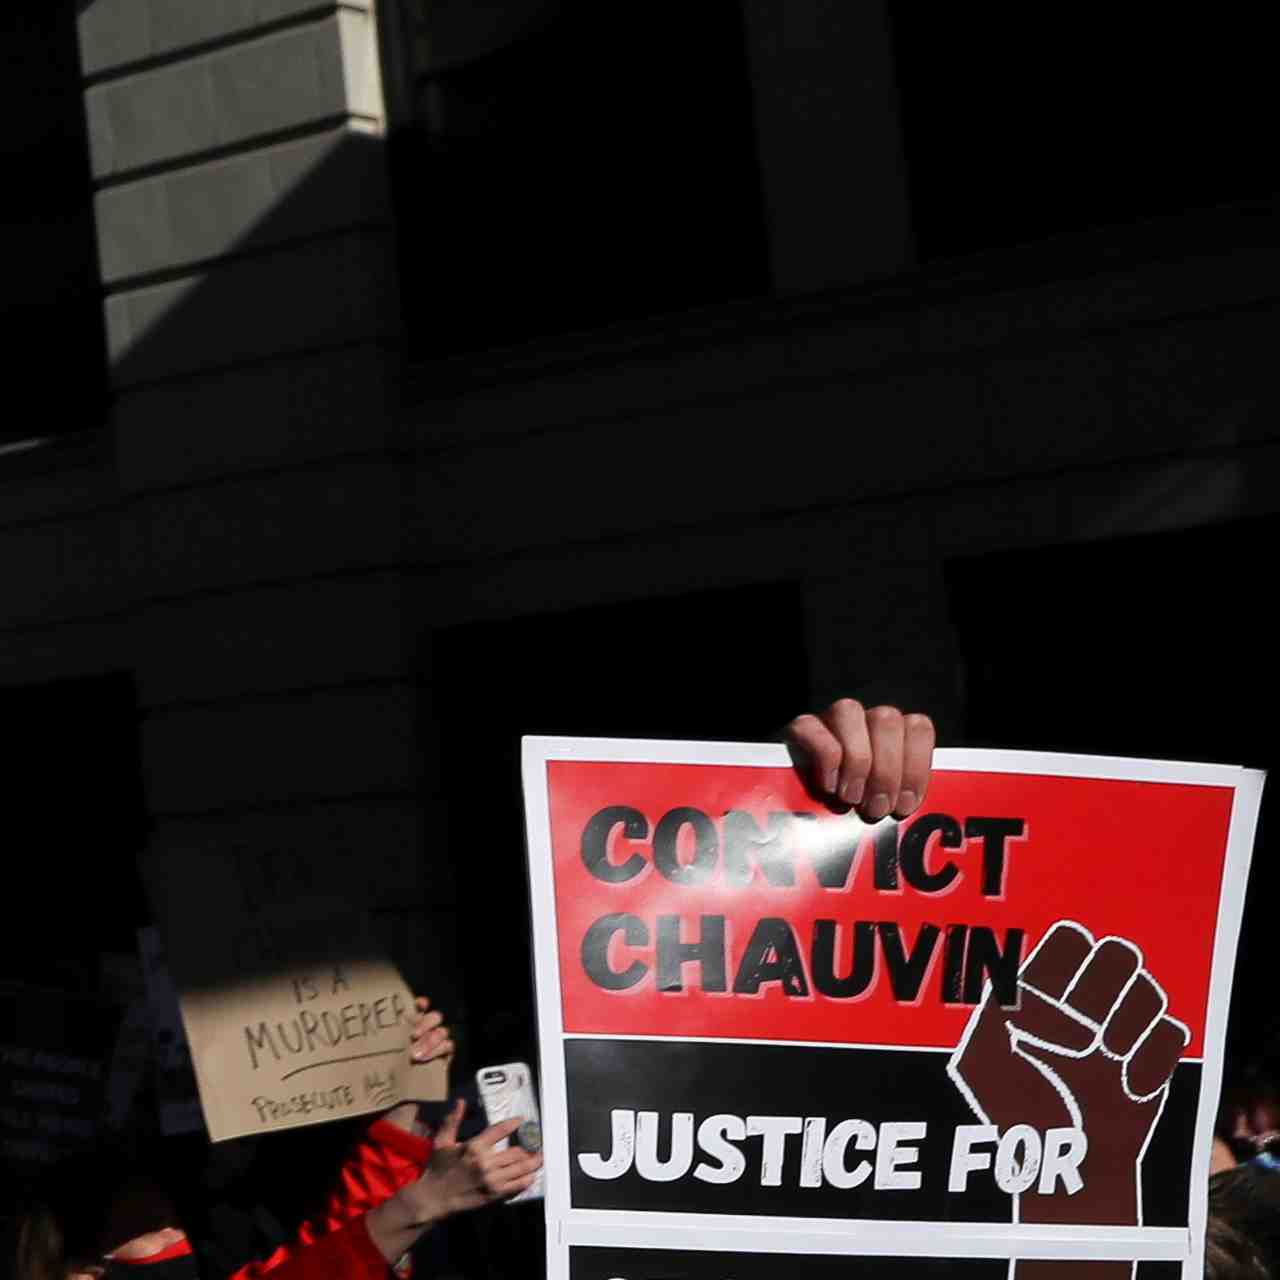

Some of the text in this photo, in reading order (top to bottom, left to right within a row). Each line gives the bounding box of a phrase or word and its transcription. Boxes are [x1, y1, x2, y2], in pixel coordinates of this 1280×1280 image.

[579, 806, 1028, 898] CONVICT
[579, 911, 1027, 1011] CHAUVIN
[577, 1109, 1089, 1197] JUSTICE FOR
